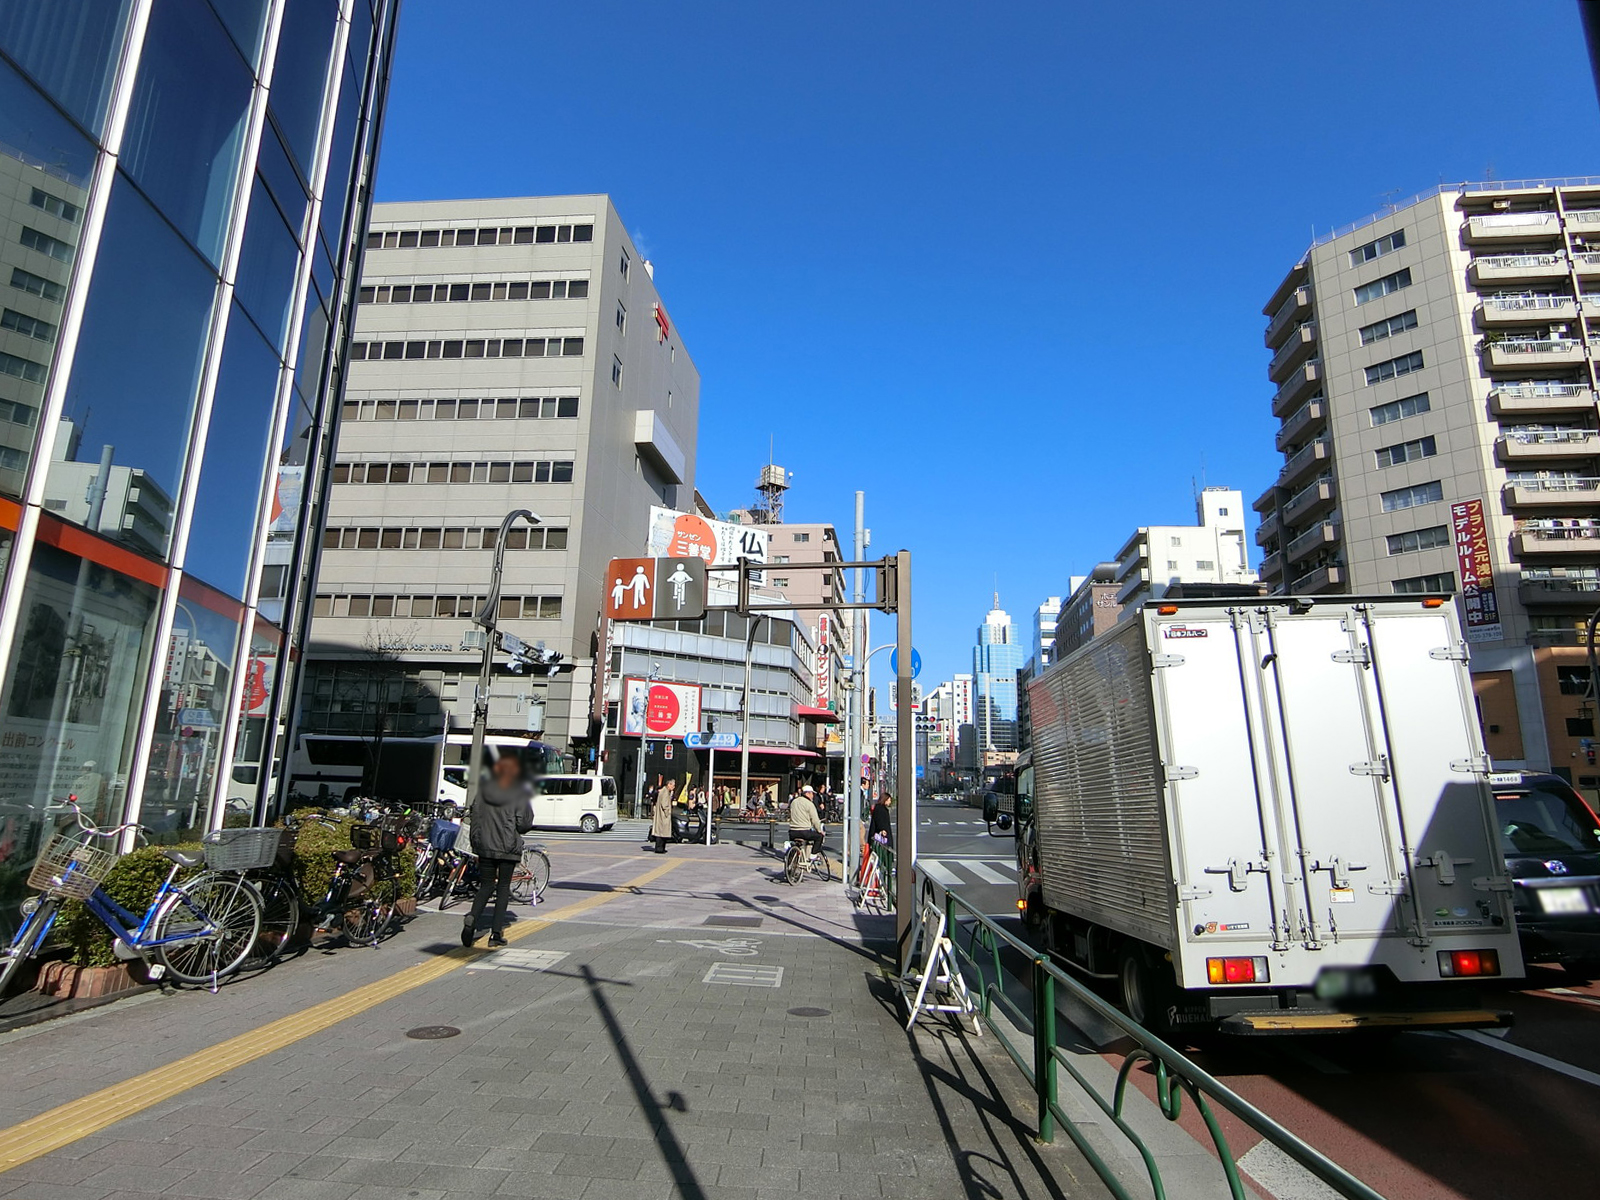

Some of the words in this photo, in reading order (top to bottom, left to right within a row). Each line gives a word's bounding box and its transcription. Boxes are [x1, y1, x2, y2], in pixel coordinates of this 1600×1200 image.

[677, 530, 702, 541] サンゼン
[1453, 505, 1482, 623] モデルルーム公開中
[1468, 501, 1492, 588] ブランズ元浅草
